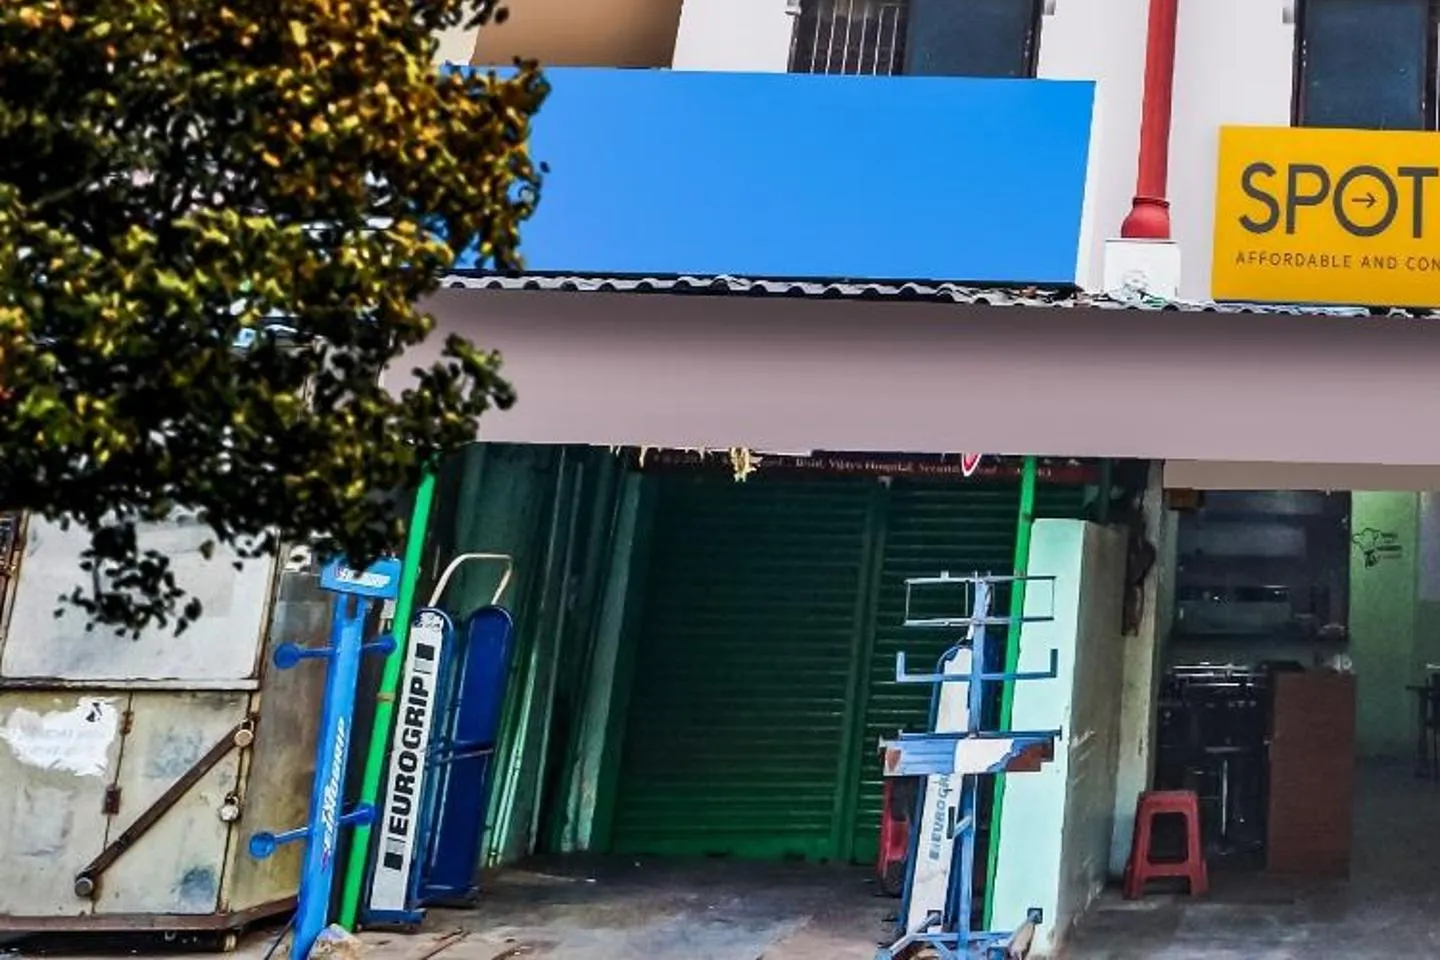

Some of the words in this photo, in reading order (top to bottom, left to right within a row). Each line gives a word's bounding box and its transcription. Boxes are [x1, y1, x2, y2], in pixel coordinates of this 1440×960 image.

[1238, 161, 1439, 240] SPOT
[1236, 251, 1351, 270] AFFORDABLE
[1360, 256, 1398, 271] AND
[389, 675, 431, 839] EUROGRIP
